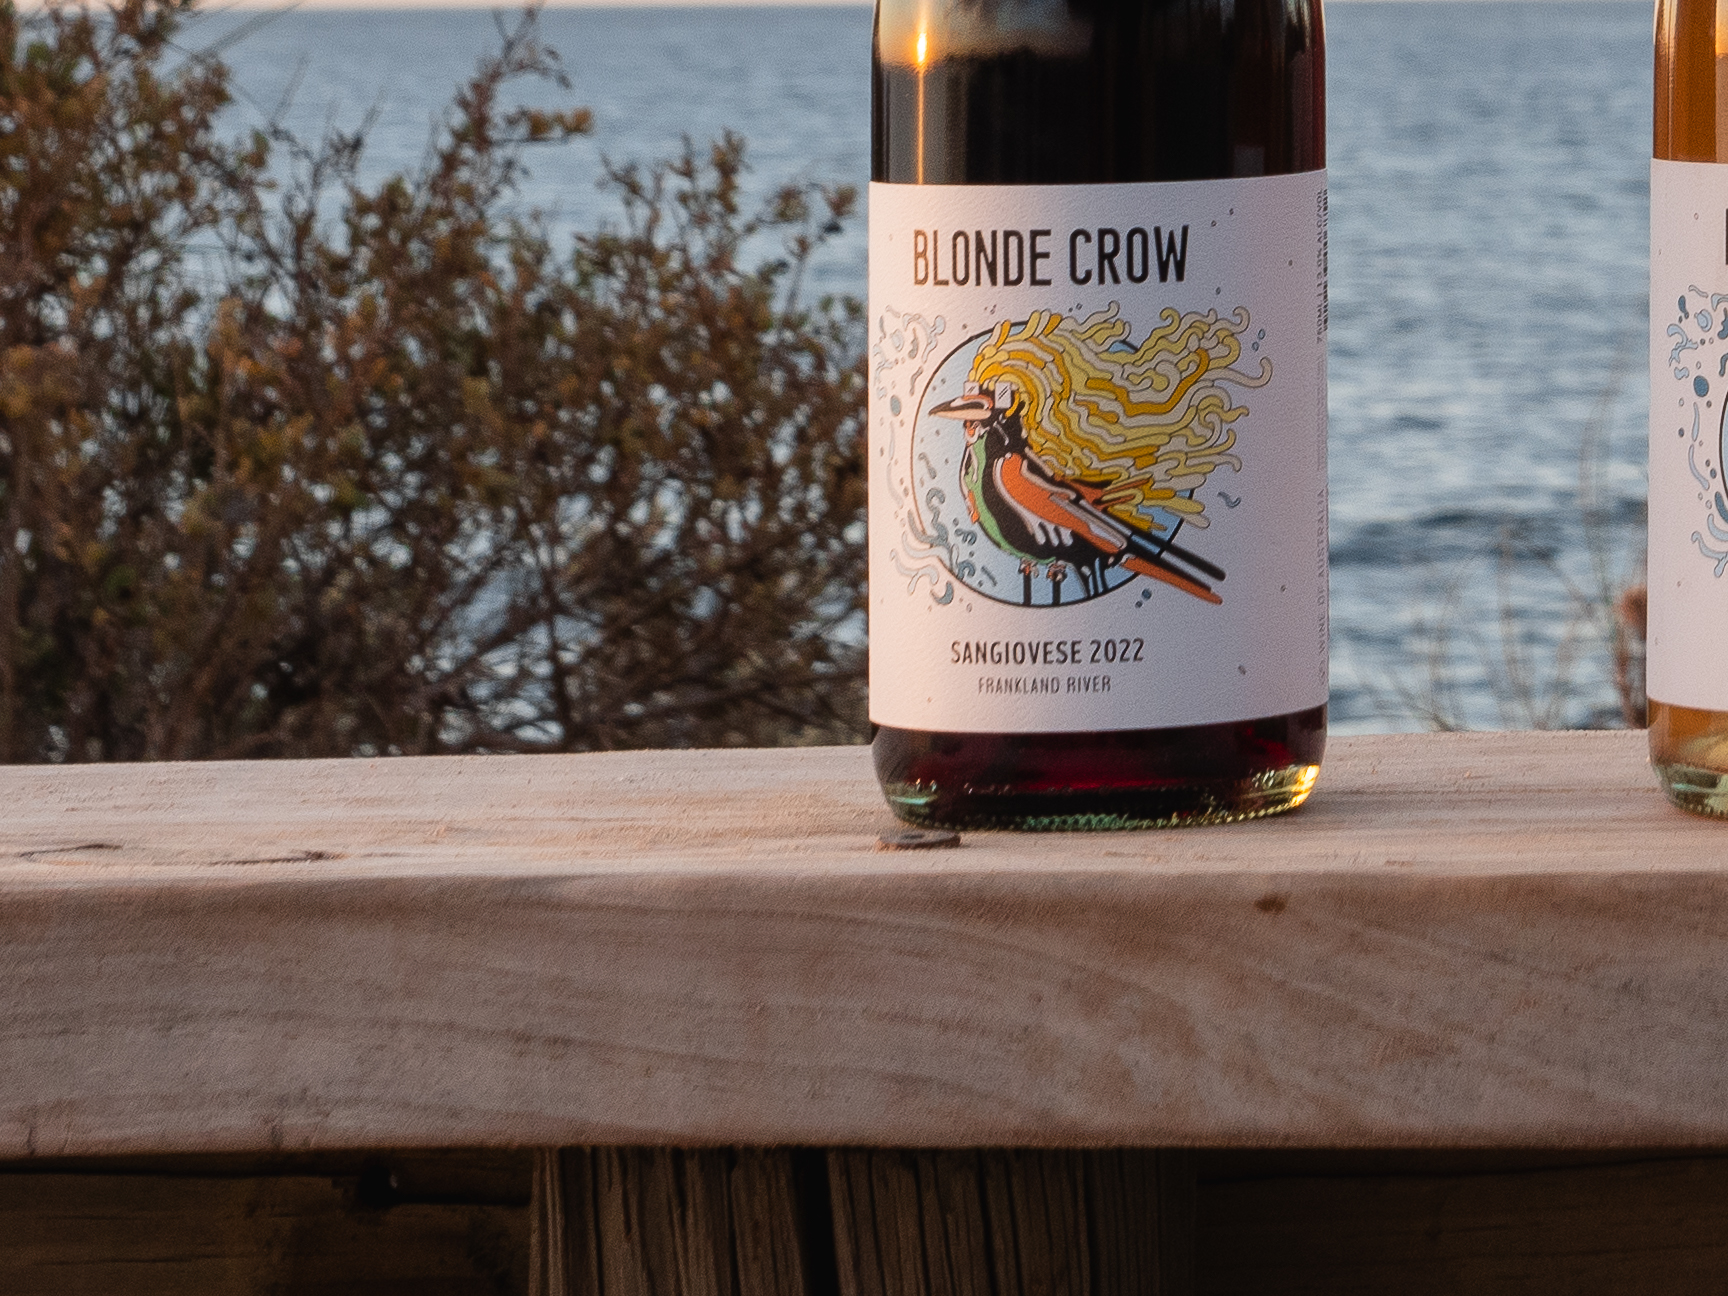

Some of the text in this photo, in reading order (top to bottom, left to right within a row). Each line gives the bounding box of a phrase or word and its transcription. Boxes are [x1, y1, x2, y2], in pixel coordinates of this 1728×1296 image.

[912, 224, 1189, 287] BLONDE CROW
[951, 637, 1145, 665] SANGIOVESE 2022
[979, 675, 1111, 695] FRANKLAND RIVER
